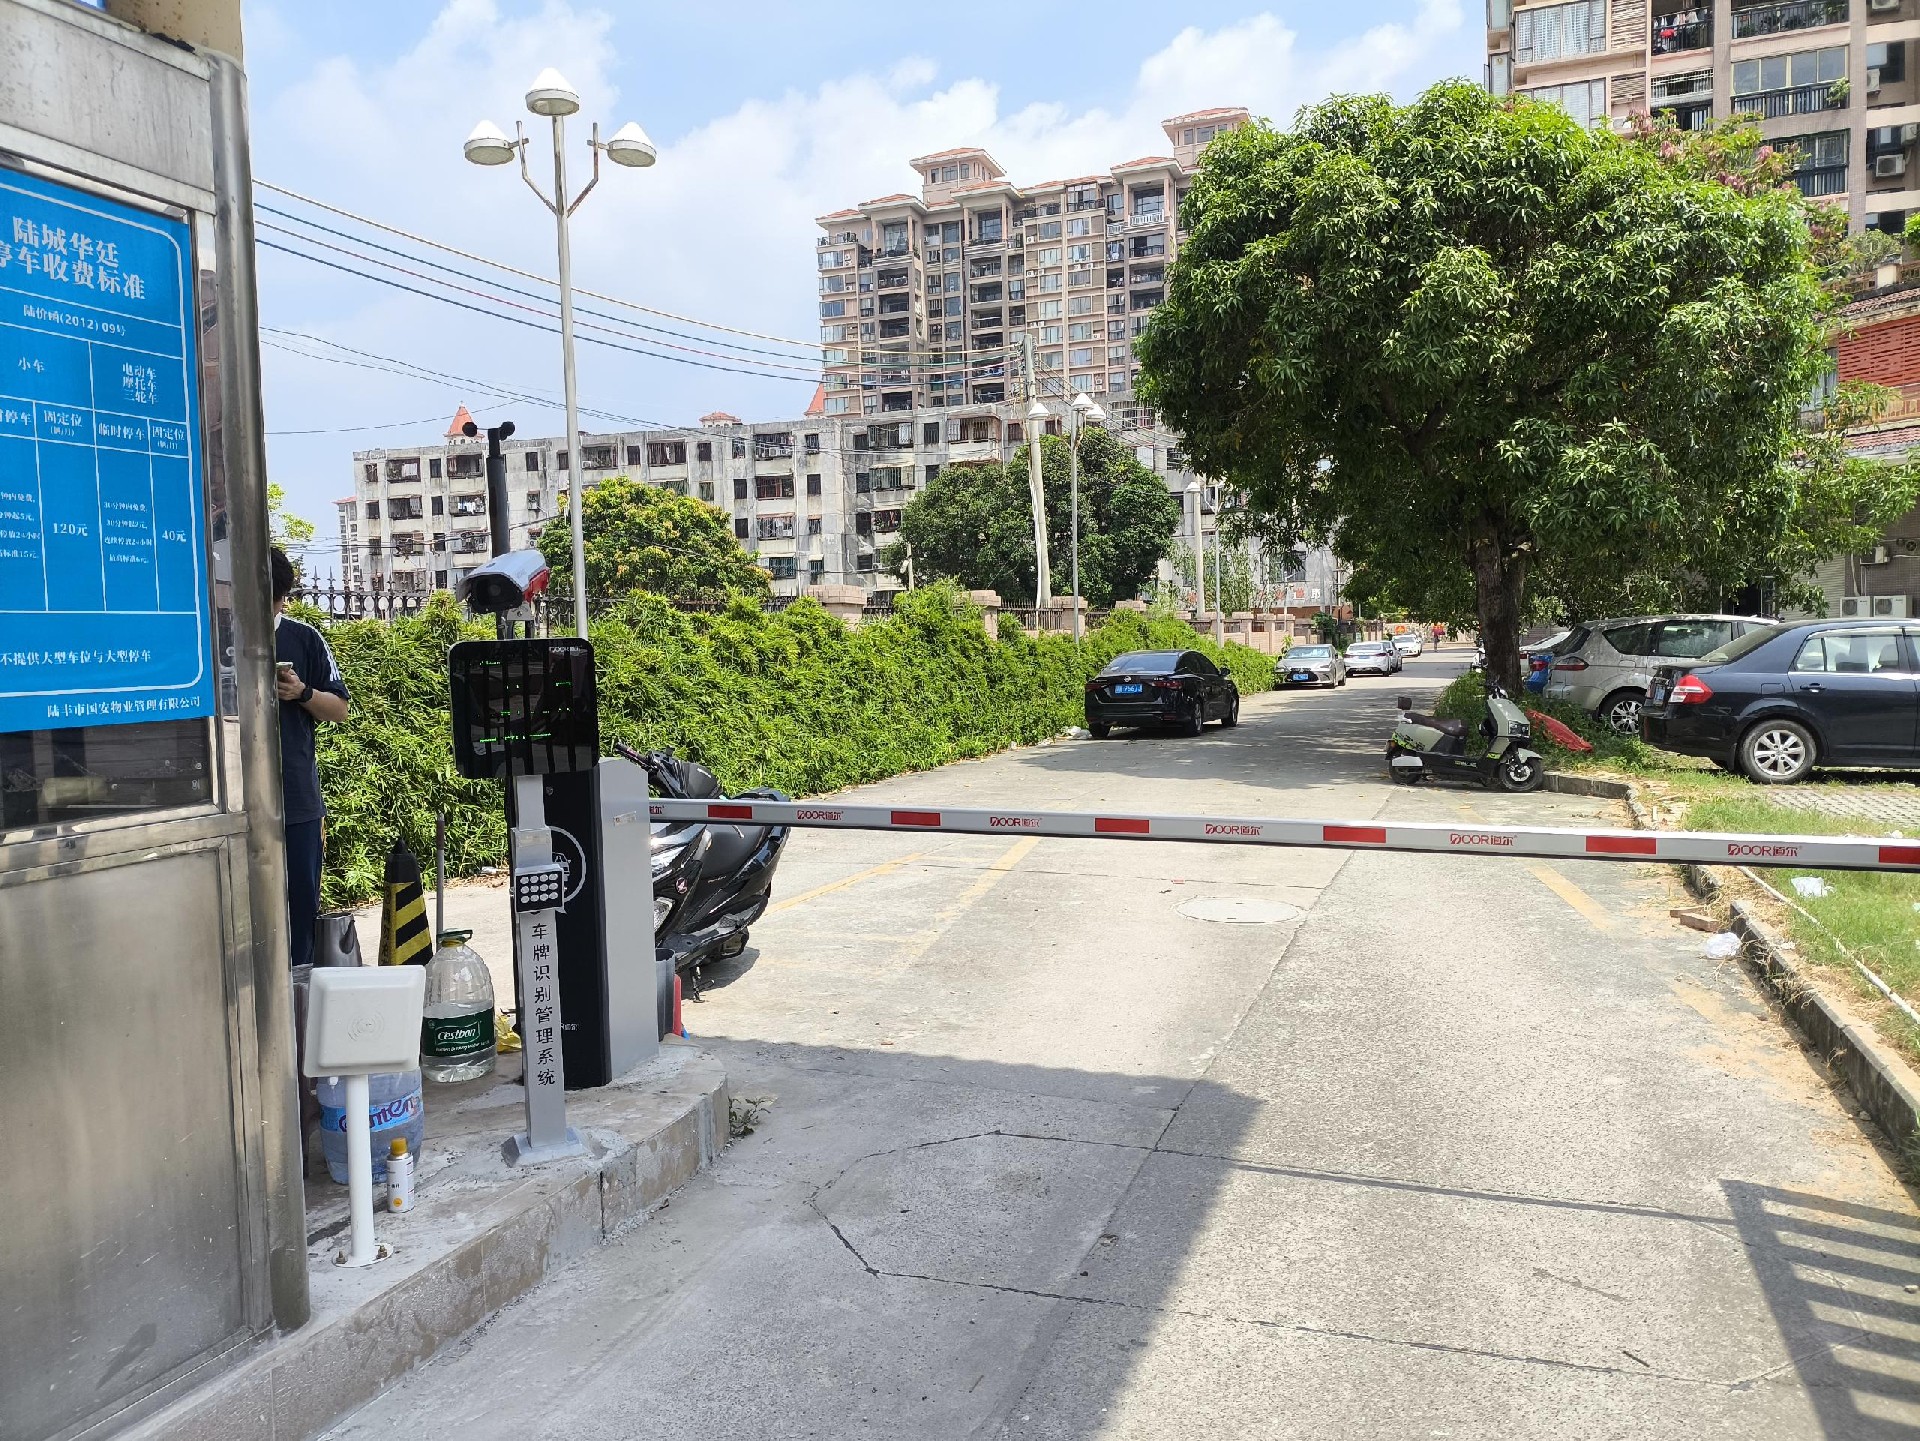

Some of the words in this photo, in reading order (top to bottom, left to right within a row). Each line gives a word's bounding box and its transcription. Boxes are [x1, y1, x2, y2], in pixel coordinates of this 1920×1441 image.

[13, 216, 119, 268] 陆城华廷
[18, 357, 45, 373] 小车
[122, 362, 157, 380] 电动车
[98, 422, 146, 441] 临时停车
[52, 522, 89, 538] 120元
[161, 529, 187, 543] 40元
[47, 695, 200, 719] 陆丰市国安物业管理有限公司
[531, 922, 556, 1086] 车牌识别管理系统
